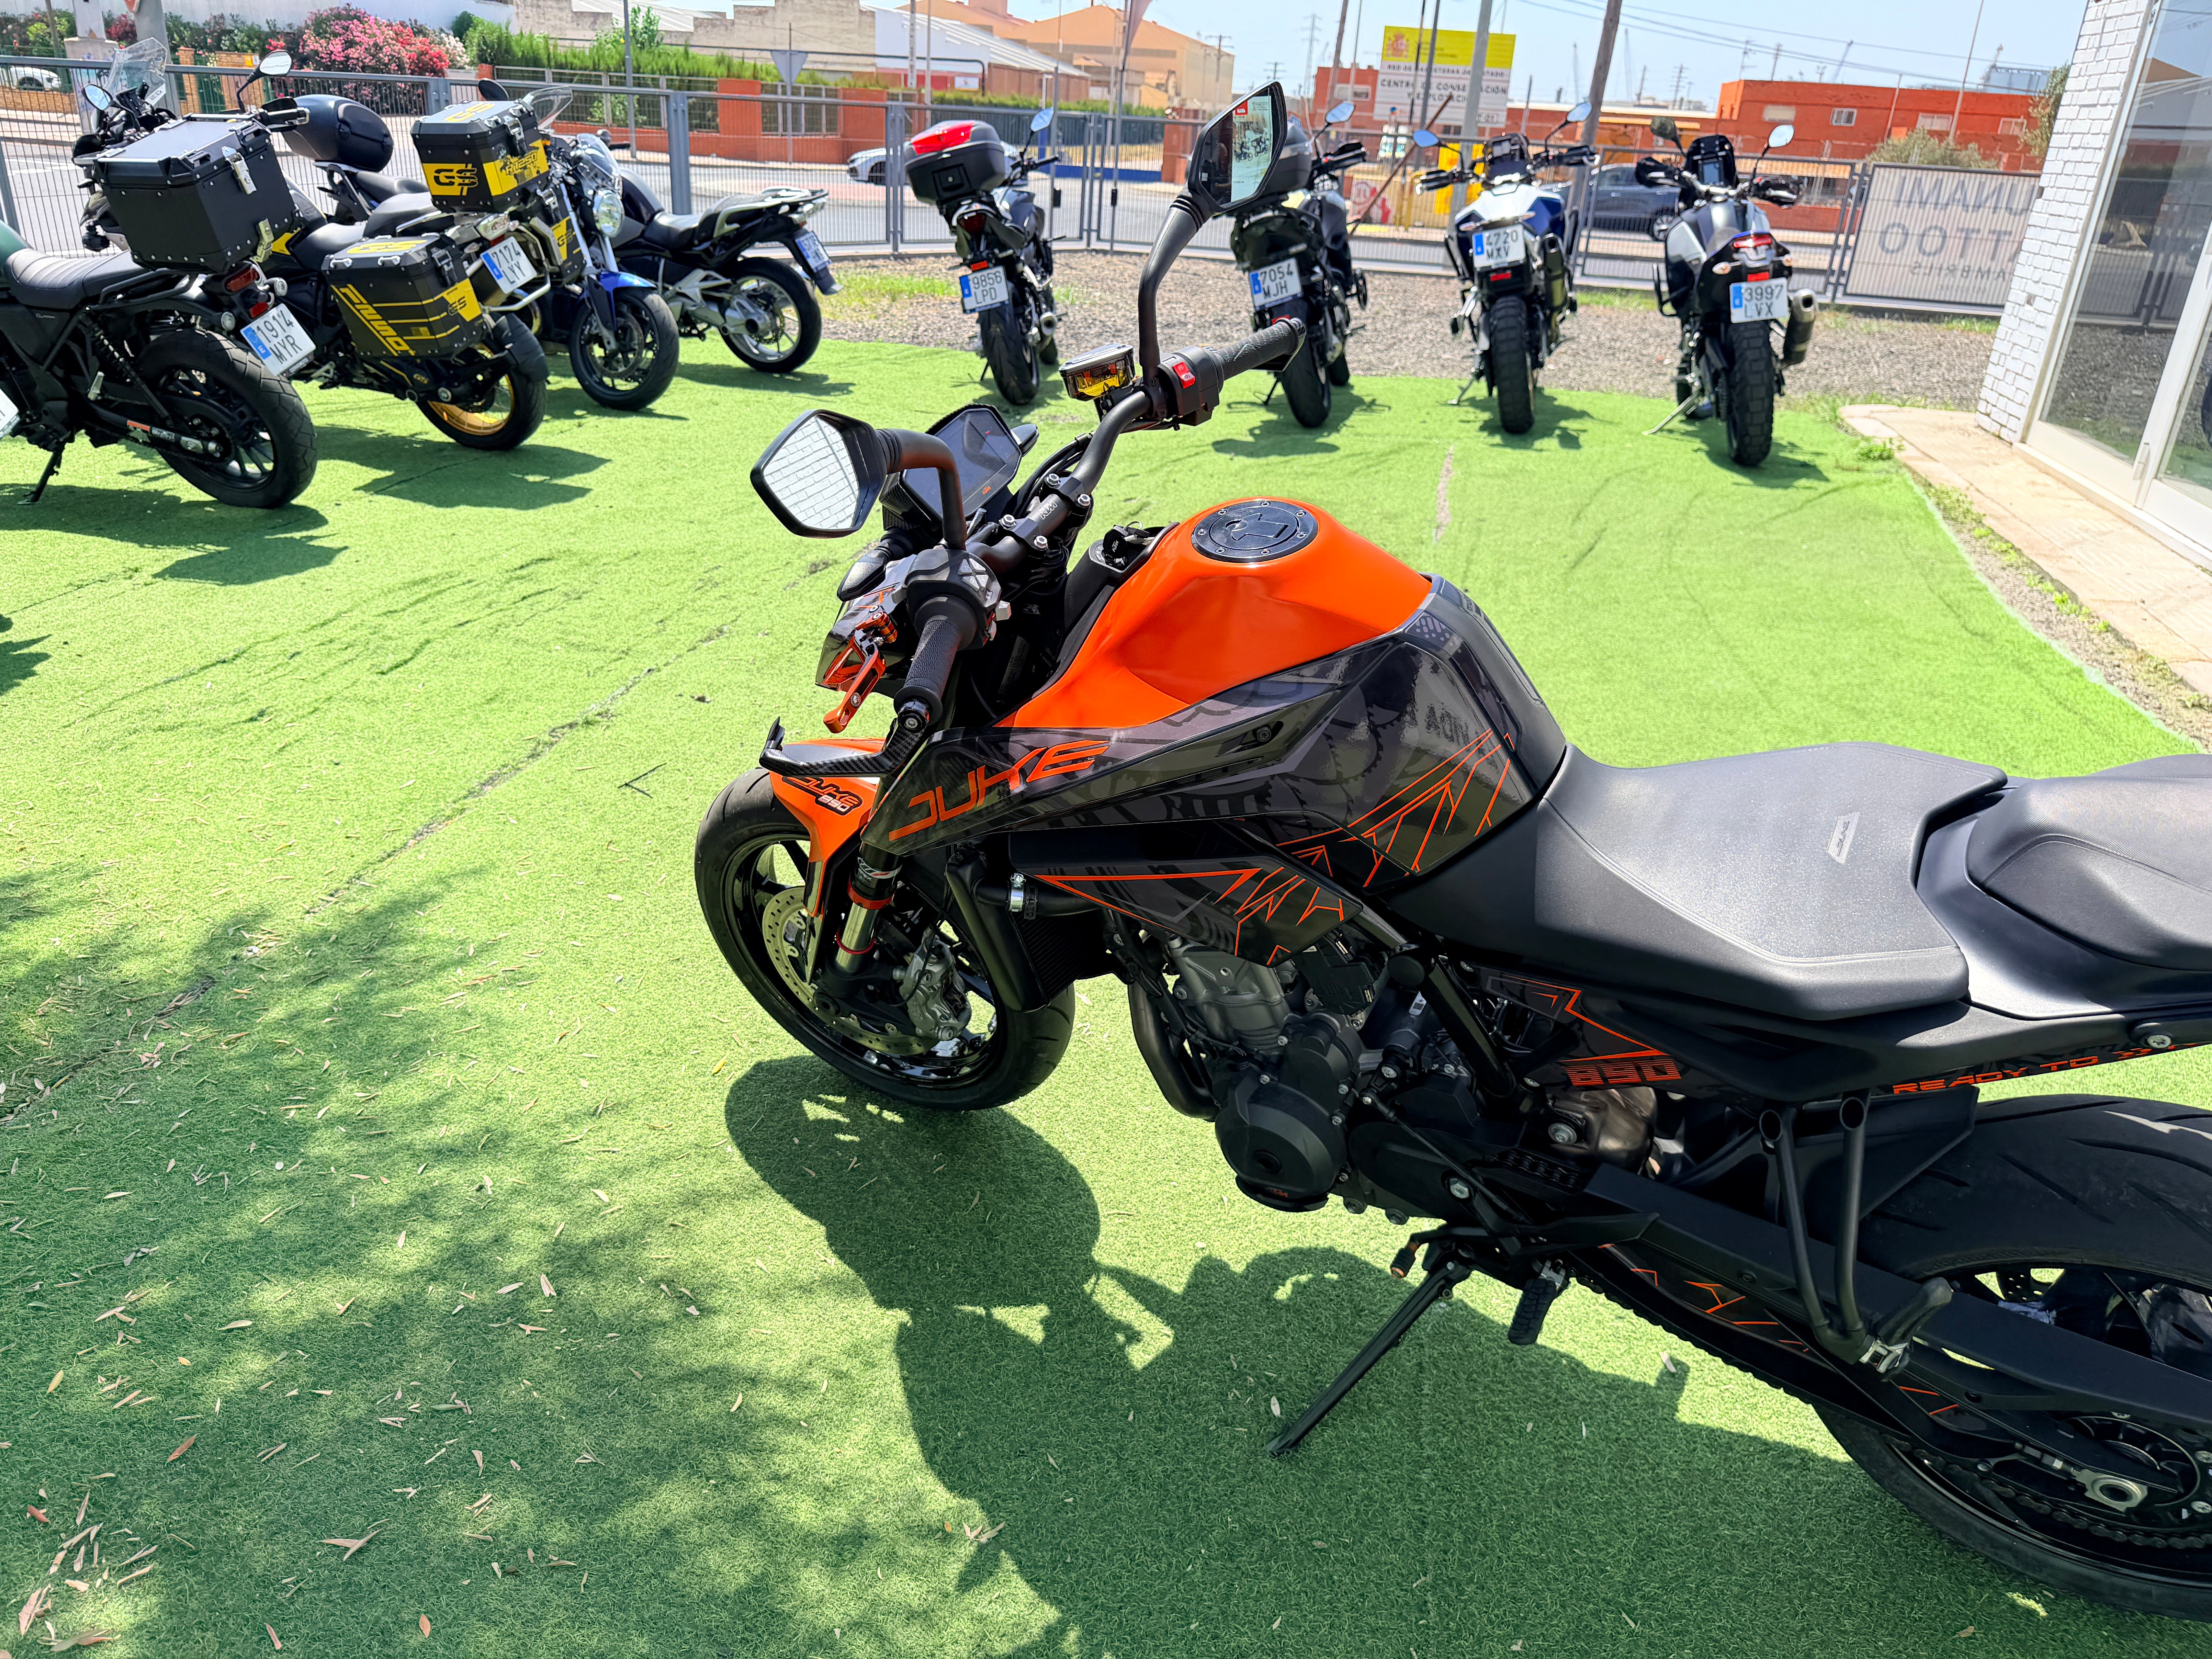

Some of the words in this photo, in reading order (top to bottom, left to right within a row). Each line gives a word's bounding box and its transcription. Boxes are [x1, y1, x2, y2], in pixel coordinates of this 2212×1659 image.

[433, 167, 479, 188] GS
[491, 242, 521, 268] 7174
[502, 261, 526, 284] LYY
[972, 271, 1003, 289] 9856
[1260, 263, 1293, 285] 7054
[974, 287, 998, 304] LPD
[1263, 280, 1288, 300] MJH
[1745, 283, 1784, 302] 3997
[1744, 301, 1773, 318] LVX
[257, 310, 294, 343] 1914
[269, 335, 302, 364] MYR
[1038, 501, 1058, 520] KTM
[786, 776, 859, 806] DUKE
[889, 739, 1110, 842] DUKE
[817, 794, 850, 812] 890
[1561, 1059, 1682, 1086] 890
[1892, 1066, 2028, 1094] READY
[2040, 1056, 2099, 1072] TO
